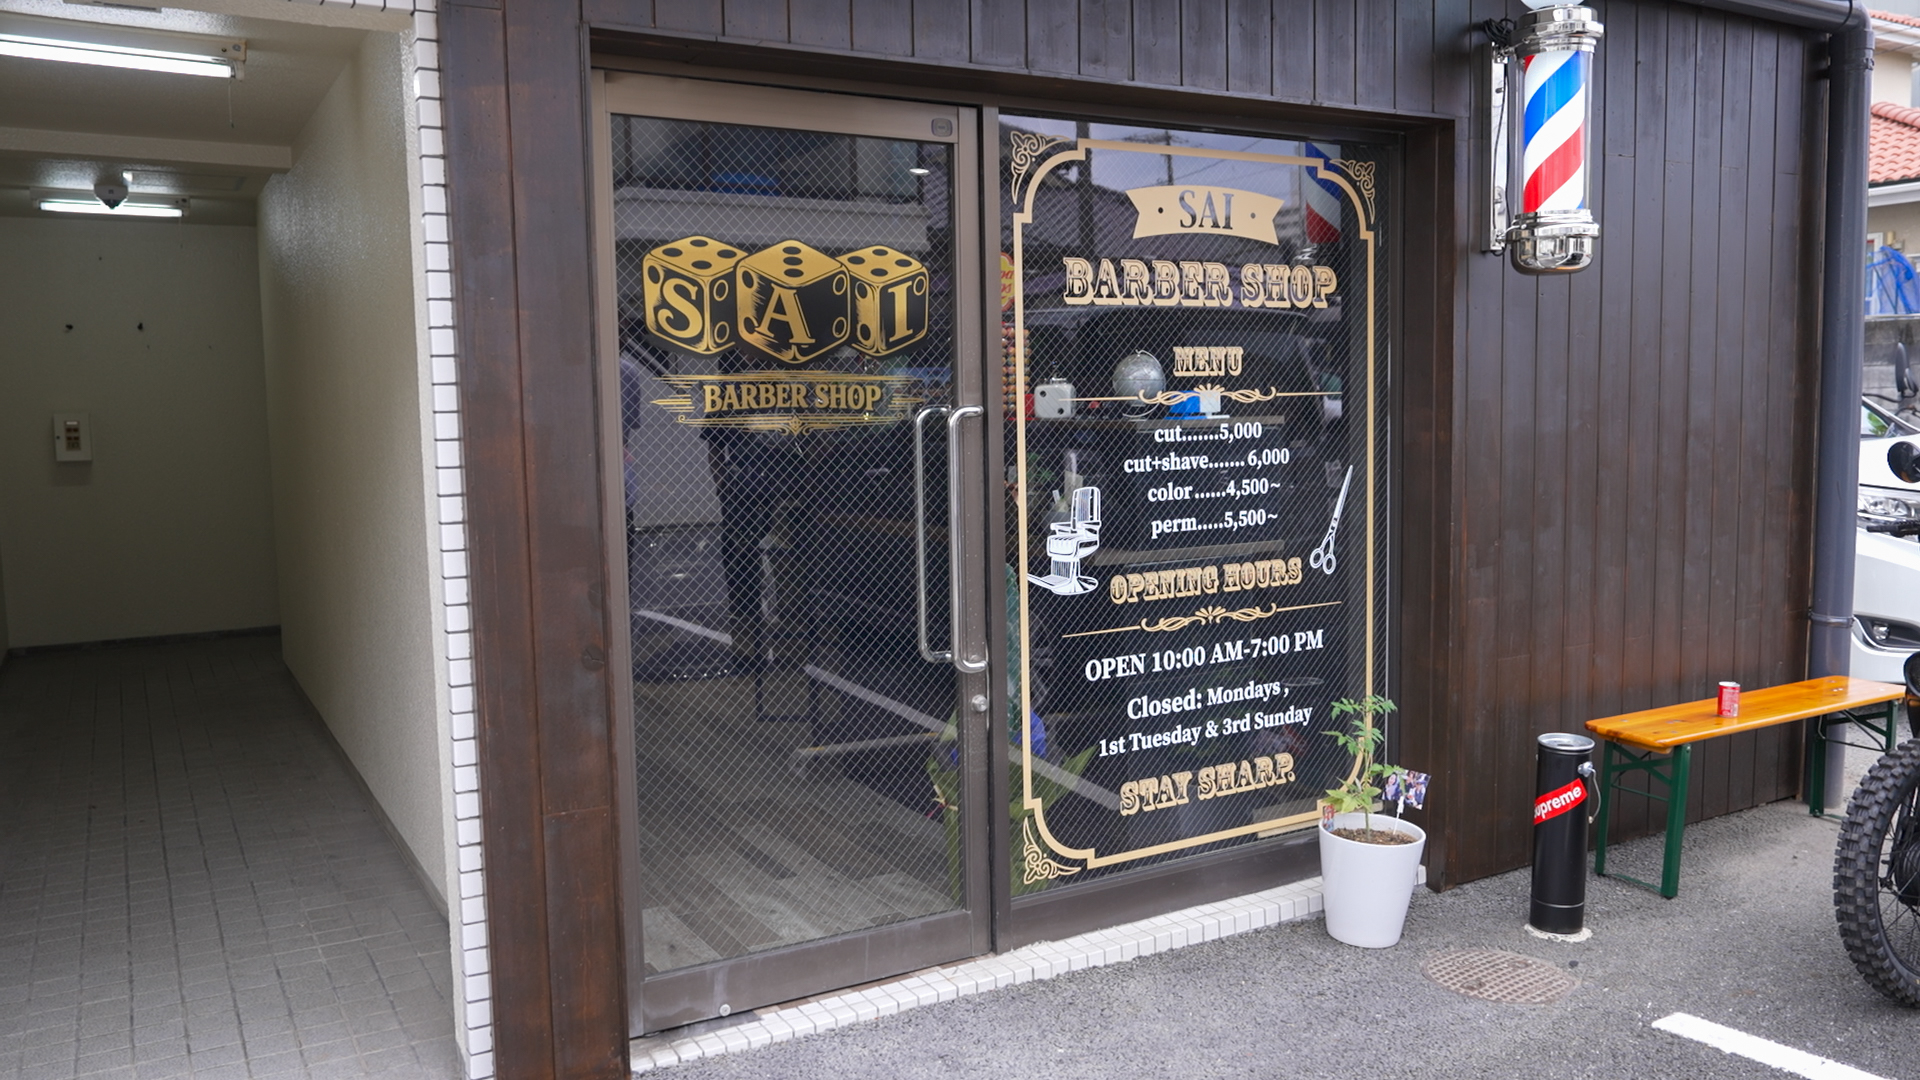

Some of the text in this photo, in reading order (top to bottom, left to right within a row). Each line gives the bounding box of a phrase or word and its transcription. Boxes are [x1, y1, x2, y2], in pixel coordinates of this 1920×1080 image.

[1177, 188, 1235, 231] SAI
[1063, 256, 1338, 309] BARBER SHOP
[1172, 346, 1244, 377] MENU
[702, 383, 883, 413] BARBER SHOP
[1247, 447, 1291, 470] 6,000
[1109, 556, 1304, 606] OPENING HOURS
[1084, 652, 1147, 682] OPEN
[1151, 645, 1207, 673] 10:00
[1293, 628, 1325, 653] PM
[1126, 687, 1203, 721] Closed:
[1098, 704, 1314, 758] 1st Tuesday & 3rd Sunday
[1119, 770, 1193, 818] STAY
